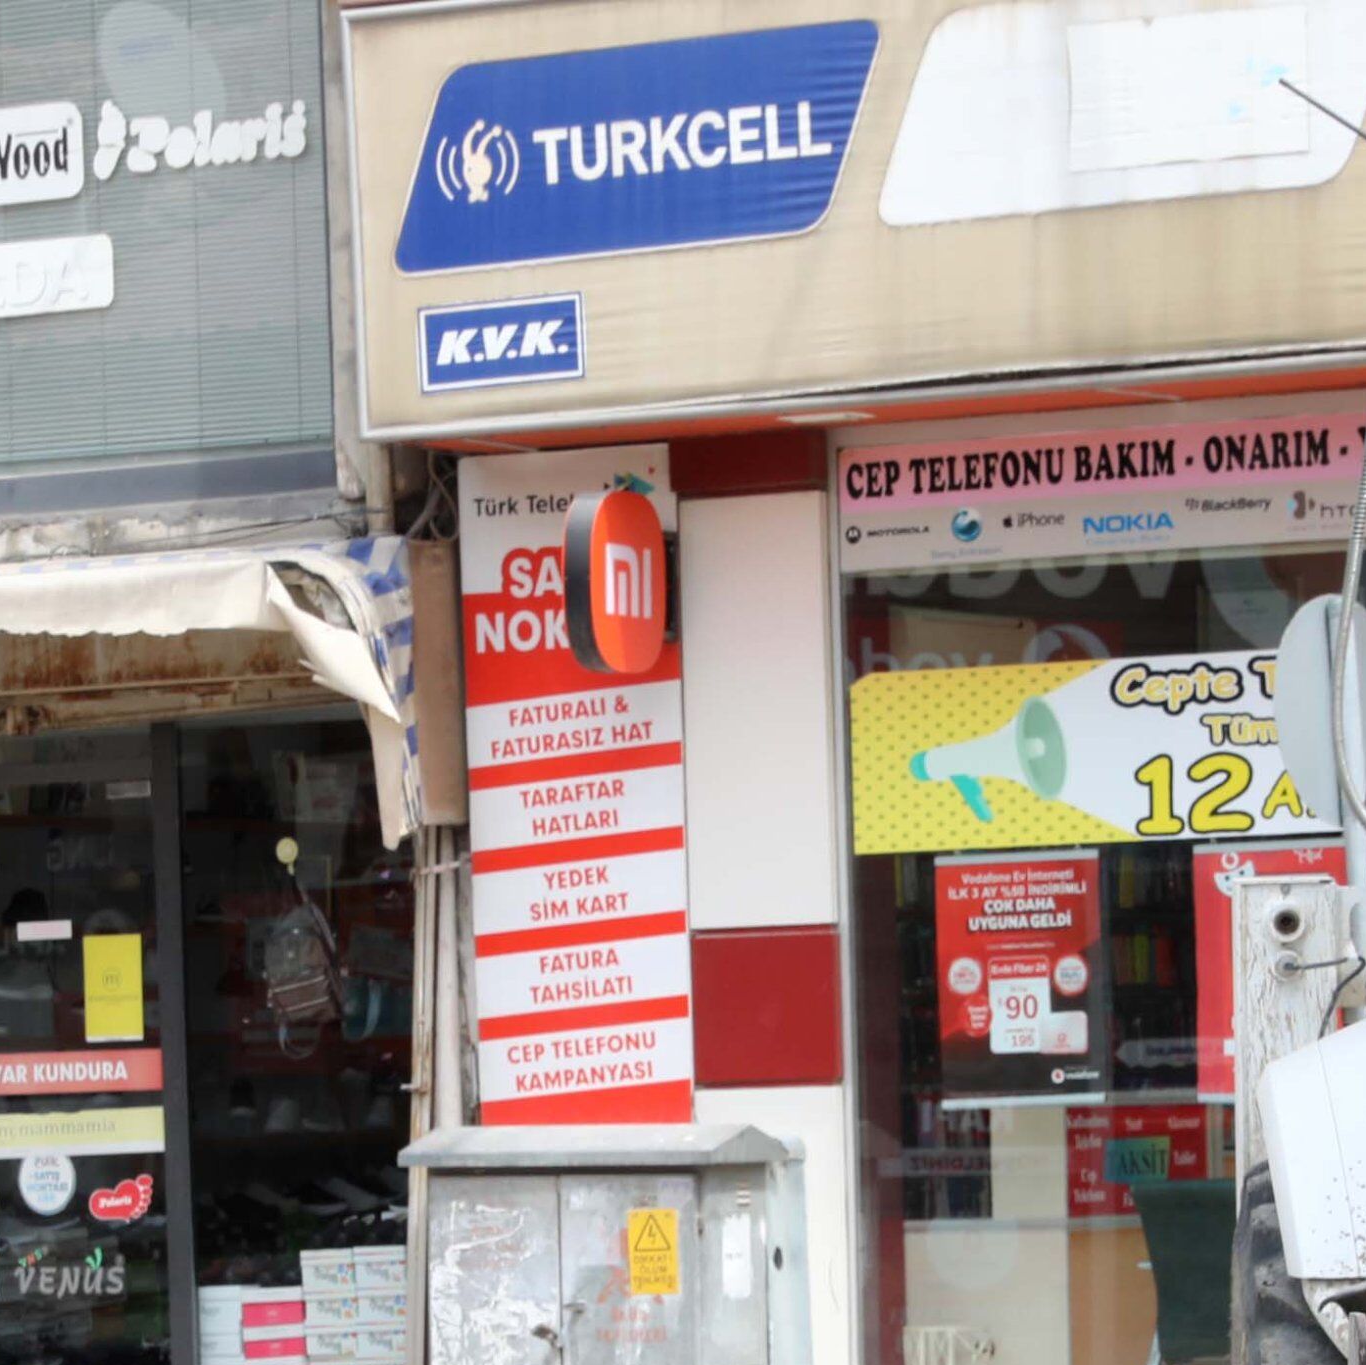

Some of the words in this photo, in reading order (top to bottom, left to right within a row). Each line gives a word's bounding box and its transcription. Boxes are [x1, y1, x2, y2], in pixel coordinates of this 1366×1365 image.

[532, 101, 832, 185] TURKCELL
[846, 459, 900, 499] CEP
[909, 447, 1065, 493] TELEFONU
[1075, 439, 1176, 480] BAKIM
[1203, 428, 1331, 474] ONARIM
[473, 497, 519, 517] Türk
[526, 493, 575, 514] Tele
[1017, 513, 1065, 527] iPhone
[1083, 512, 1174, 534] NOKIA
[1201, 497, 1272, 513] BlackBerry
[509, 556, 563, 599] SA
[1111, 662, 1244, 715] Cepte
[508, 697, 607, 728] FATURALI
[613, 694, 630, 713] &
[491, 728, 605, 760] FATURASIZ
[611, 721, 654, 744] HAT
[520, 778, 624, 809] TARAFTAR
[532, 808, 620, 837] HATLARI
[543, 865, 609, 890] YEDEK
[981, 886, 998, 898] AY
[529, 896, 570, 922] SİM
[576, 892, 629, 916] KART
[1015, 897, 1057, 911] DAHA
[967, 915, 1029, 932] UYGUNA
[1030, 910, 1073, 928] GELDİ
[539, 948, 620, 975] FATURA
[530, 976, 634, 1005] TAHSİLATI
[1005, 995, 1039, 1020] 90
[506, 1044, 545, 1065] CEP
[551, 1030, 656, 1061] TELEFONU
[33, 1060, 129, 1082] KUNDURA
[516, 1061, 654, 1092] KAMPANYASI
